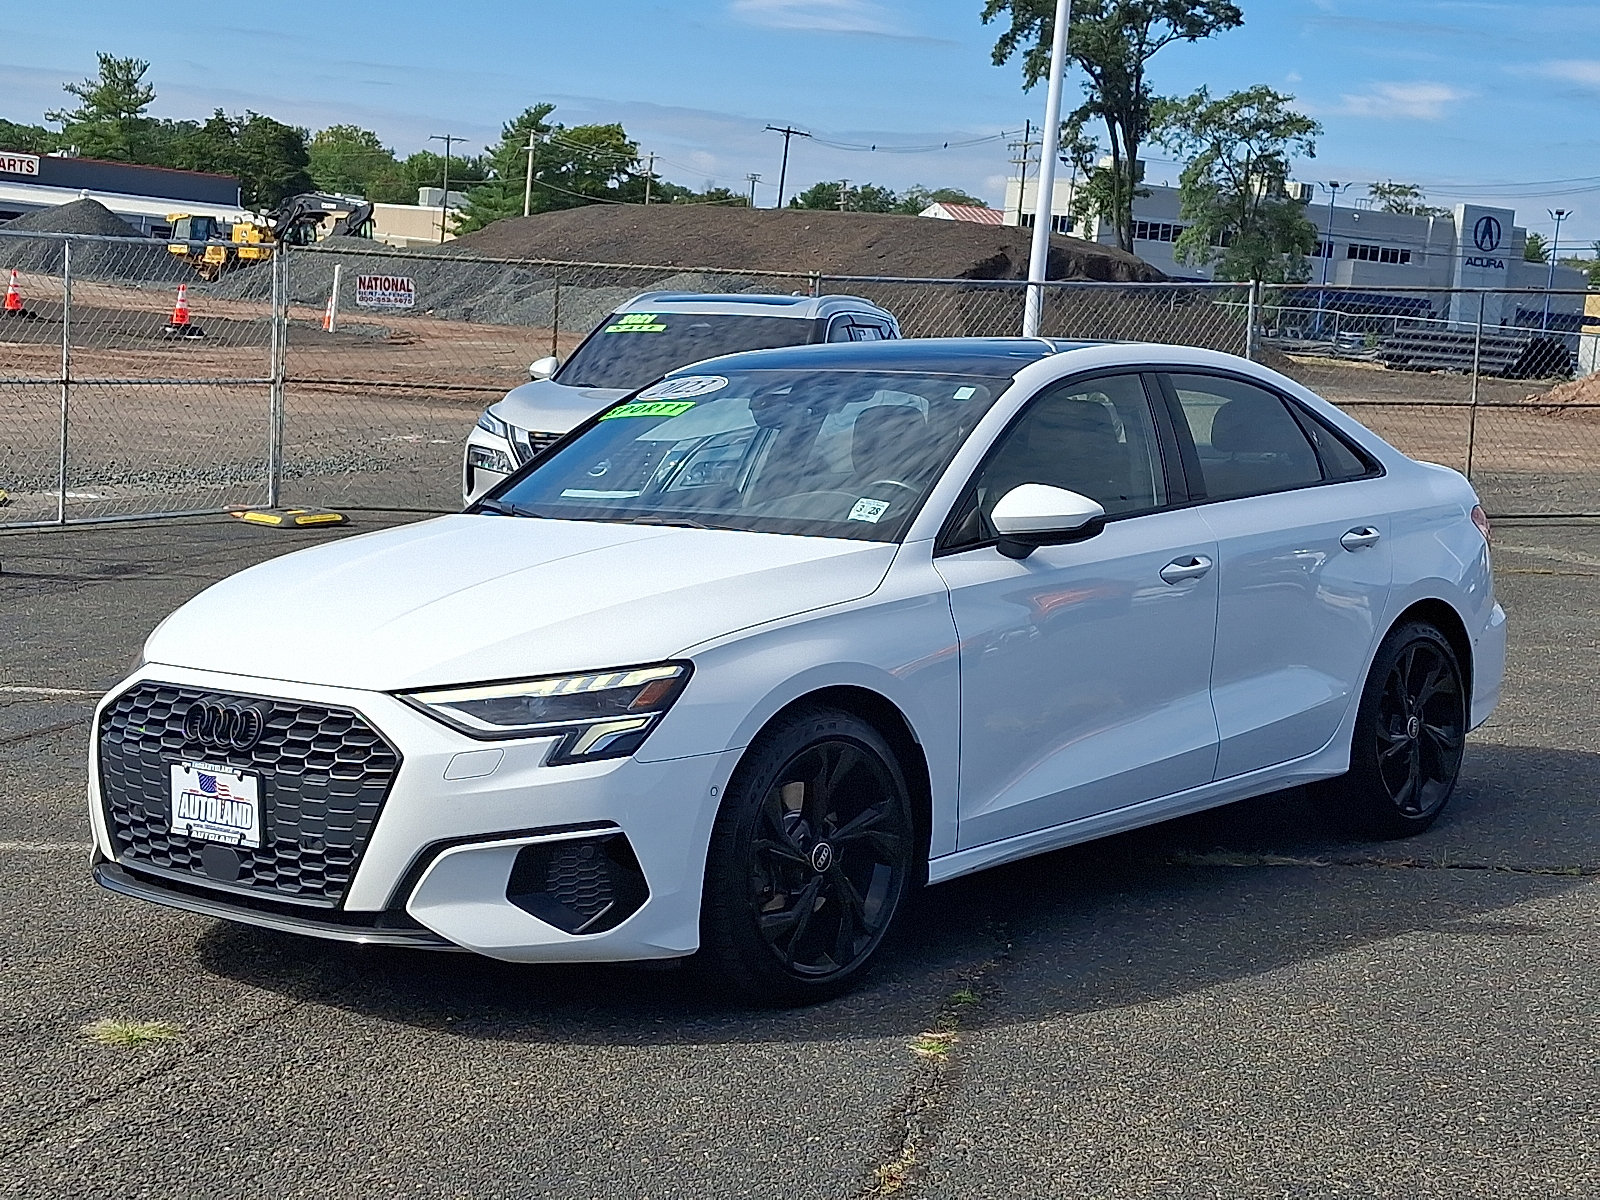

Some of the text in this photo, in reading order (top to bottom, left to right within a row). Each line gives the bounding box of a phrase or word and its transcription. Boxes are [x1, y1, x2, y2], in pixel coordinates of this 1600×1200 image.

[0, 158, 35, 173] ARTS
[1465, 257, 1504, 269] ACURA
[358, 276, 412, 292] NATIONAL
[358, 291, 412, 299] RENT-A-FENCE
[606, 403, 690, 417] SPORTY
[178, 792, 253, 830] AUTOLAND
[191, 831, 239, 845] AUTOLAND
